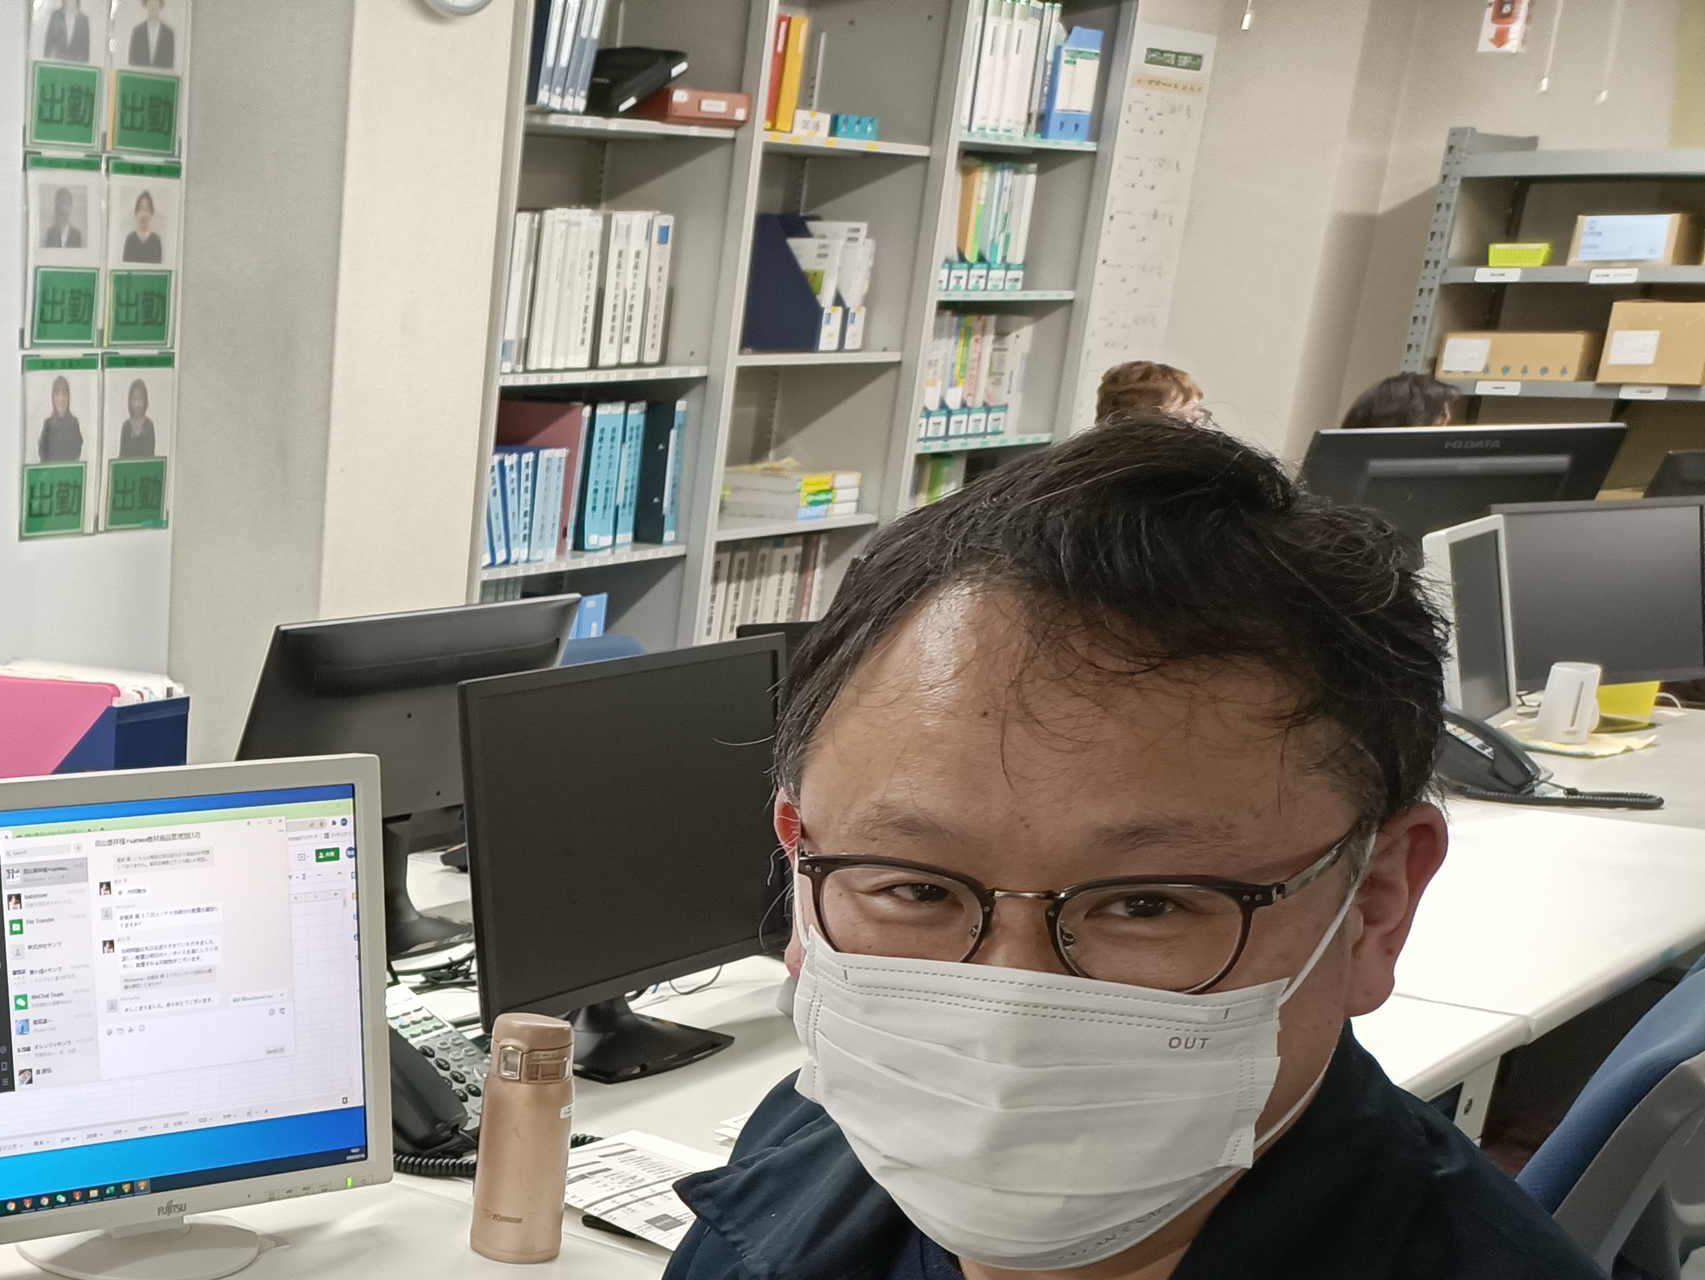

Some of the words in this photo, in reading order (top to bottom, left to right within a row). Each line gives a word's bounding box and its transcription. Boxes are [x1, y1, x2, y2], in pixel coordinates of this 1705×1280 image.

[38, 83, 95, 126] 出勤
[119, 90, 172, 135] 出勤
[41, 287, 93, 325] 出勤
[115, 289, 166, 326] 出勤
[29, 480, 81, 518] 出勤
[112, 475, 162, 511] 出勤
[1168, 1037, 1210, 1050] OUT
[157, 1200, 187, 1217] FUJITSU
